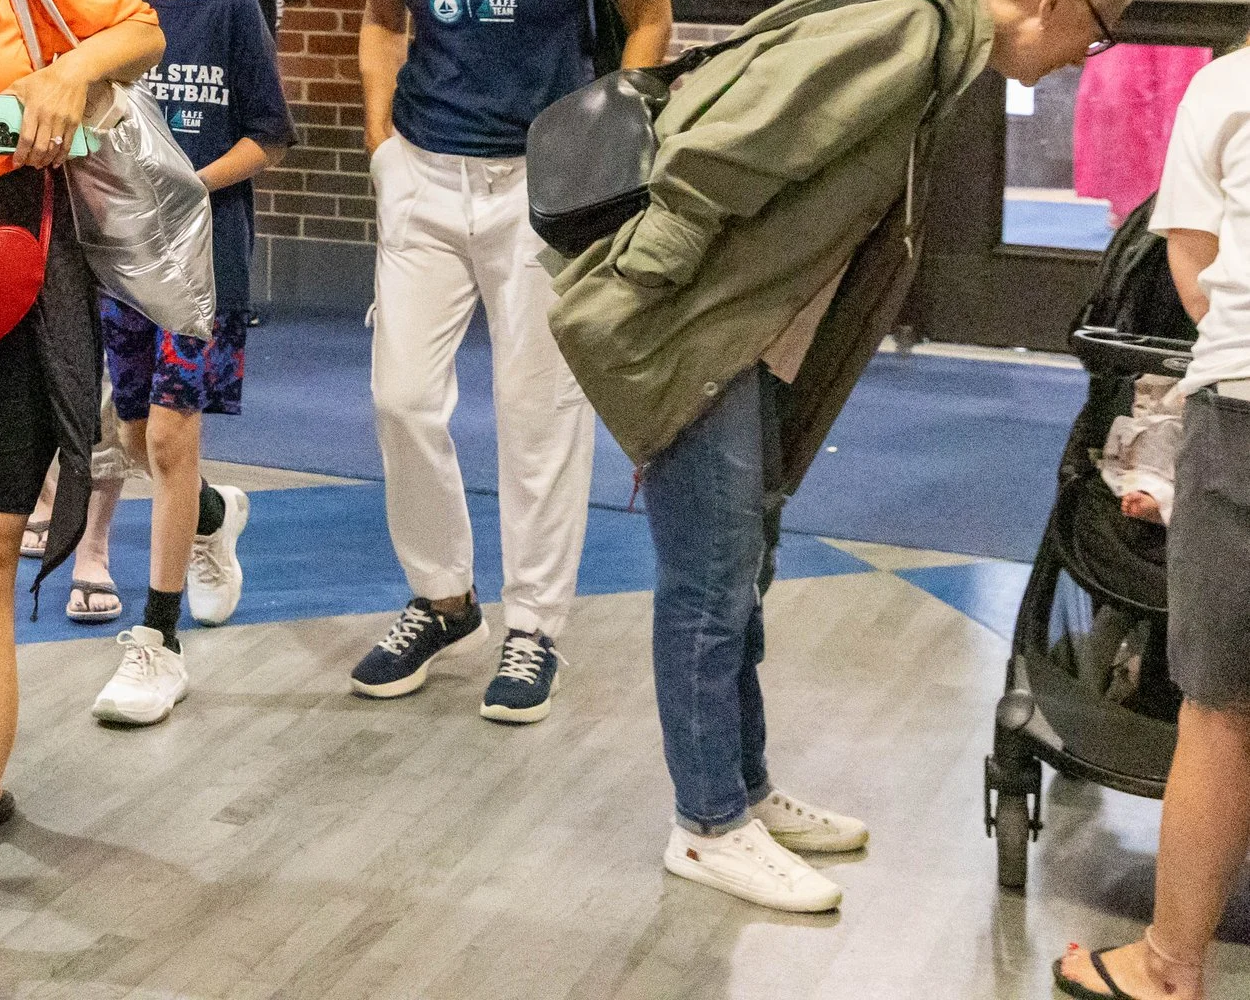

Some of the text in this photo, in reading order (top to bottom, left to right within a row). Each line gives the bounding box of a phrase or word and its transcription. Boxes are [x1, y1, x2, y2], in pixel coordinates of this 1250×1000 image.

[492, 7, 515, 16] TEAM
[168, 63, 225, 86] STAR
[181, 110, 204, 120] S.A.F.E.
[183, 119, 201, 128] TEAM
